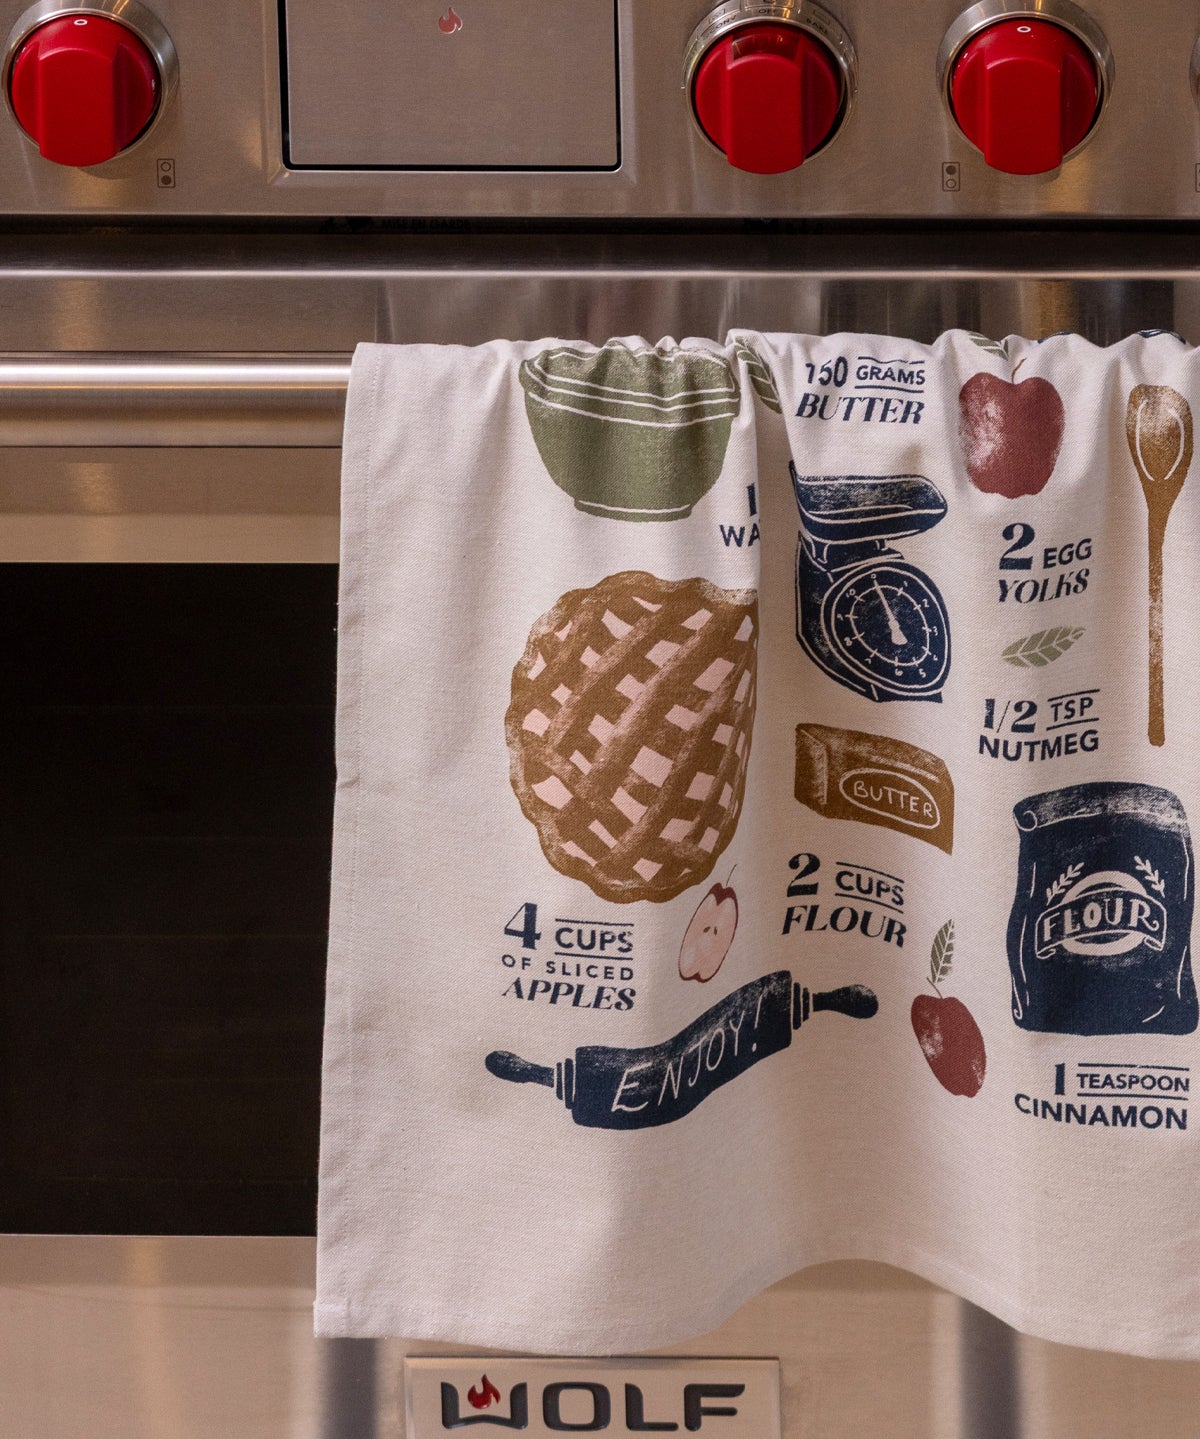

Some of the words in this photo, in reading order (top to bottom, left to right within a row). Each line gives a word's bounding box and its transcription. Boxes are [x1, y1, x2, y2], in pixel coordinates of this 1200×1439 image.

[856, 364, 926, 385] GRAMS
[795, 392, 925, 425] BUTTER
[999, 522, 1036, 571] 2
[1042, 535, 1093, 571] EGG
[922, 598, 930, 608] 2
[998, 566, 1091, 606] YOLKS
[843, 636, 853, 647] 8
[932, 625, 939, 637] 3
[894, 668, 904, 677] 6
[918, 668, 927, 678] 5
[981, 696, 1040, 735] 1/2
[1050, 696, 1096, 724] TSP
[977, 728, 1100, 763] NUTMEG
[852, 780, 934, 819] BUTTER
[785, 850, 822, 899] 2
[834, 868, 906, 909] CUPS
[502, 901, 544, 951] 4
[552, 927, 636, 955] CUPS
[781, 903, 909, 949] FLOUR
[1042, 898, 1160, 943] FLOUR
[501, 953, 534, 972] OF
[545, 959, 635, 982] SLICED
[502, 976, 638, 1012] APPLES
[611, 994, 767, 1113] ENJOY!
[1053, 1061, 1067, 1097] 1
[1076, 1072, 1191, 1093] TEASPOON
[1013, 1092, 1188, 1131] CINNAMON
[440, 1380, 746, 1432] WOLF
